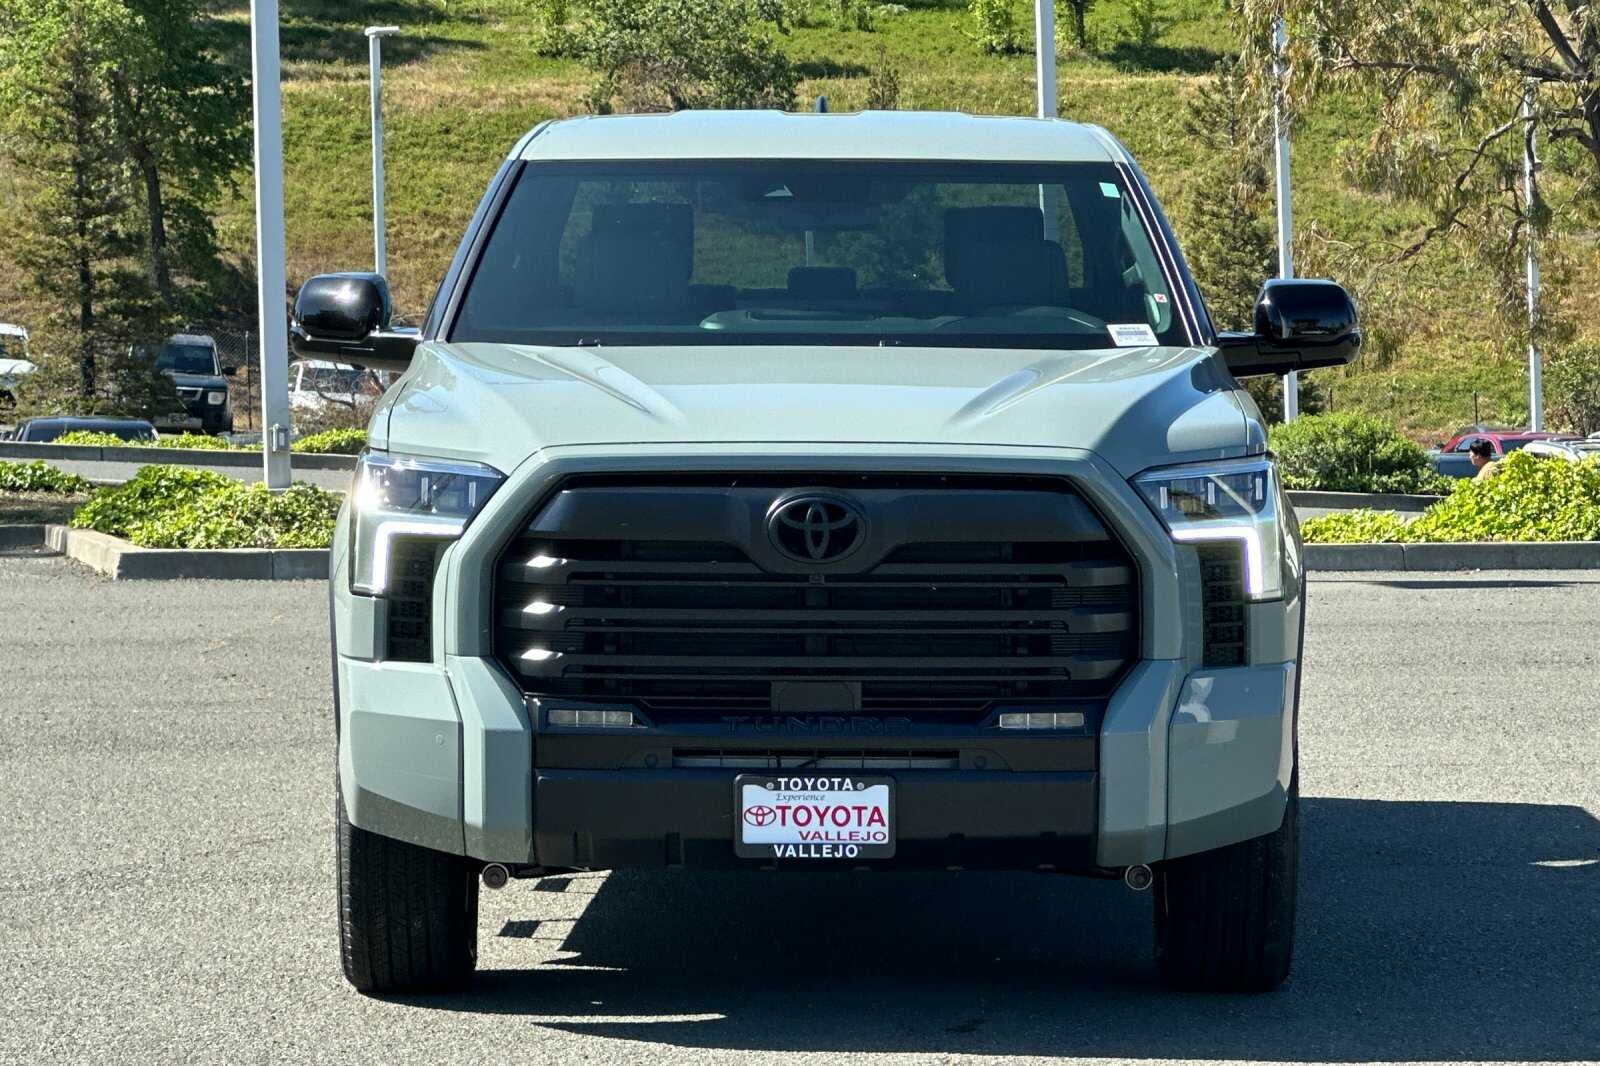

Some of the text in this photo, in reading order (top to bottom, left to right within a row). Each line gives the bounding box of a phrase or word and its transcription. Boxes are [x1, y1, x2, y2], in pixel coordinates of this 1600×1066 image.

[721, 716, 911, 736] TUNDRA
[777, 778, 853, 791] TOYOTA
[776, 793, 826, 802] Experience
[775, 805, 886, 827] TOYOTA
[798, 831, 887, 841] VALLEJO
[774, 844, 858, 858] VALLEJO
